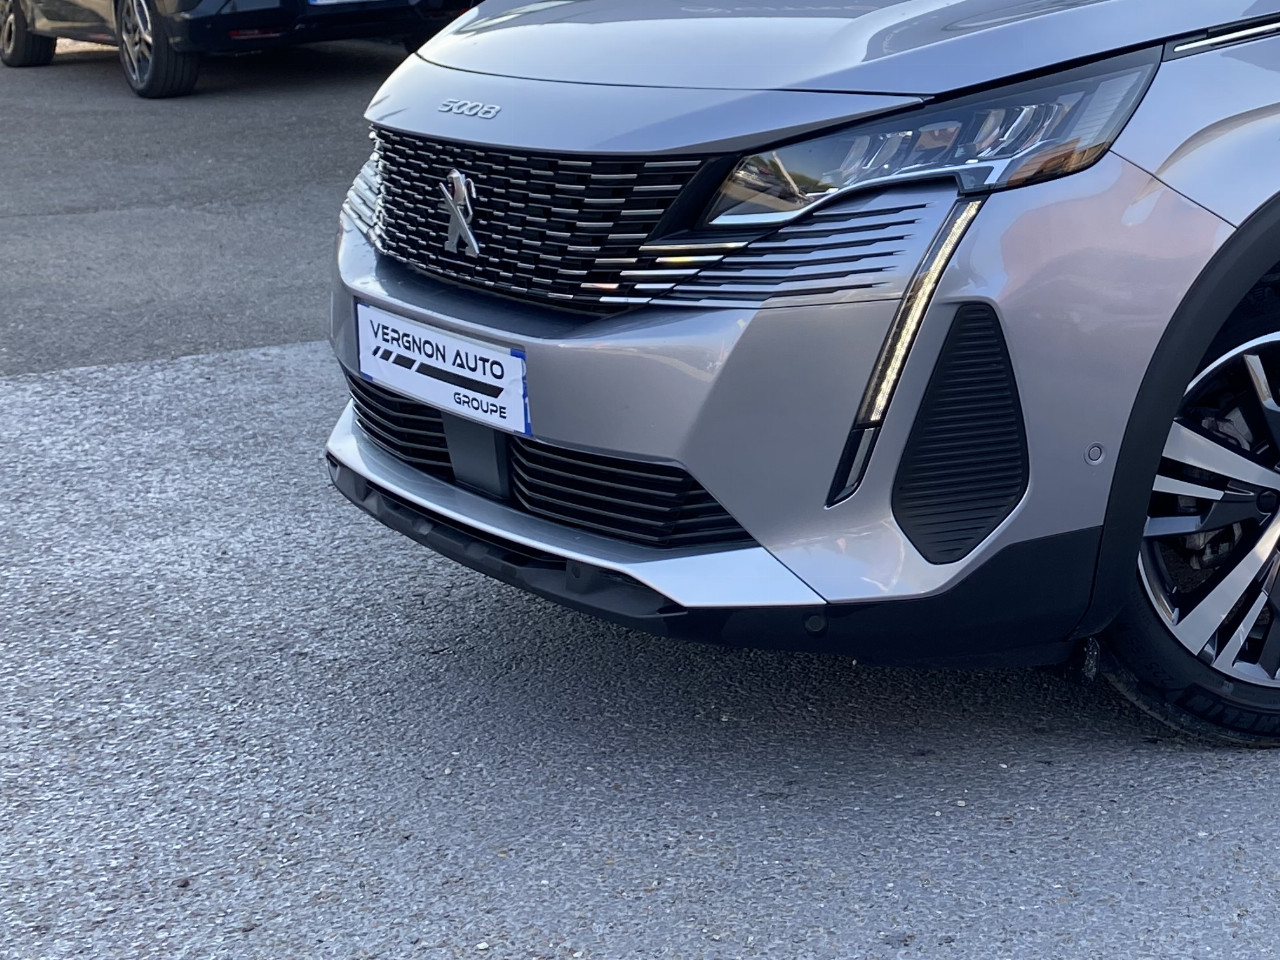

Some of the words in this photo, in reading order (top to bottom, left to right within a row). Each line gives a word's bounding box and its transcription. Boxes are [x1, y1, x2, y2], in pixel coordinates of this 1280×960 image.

[437, 98, 502, 120] 5008
[369, 320, 447, 365] VERGNON
[452, 349, 505, 380] AUTO
[453, 392, 508, 419] GROUPE
